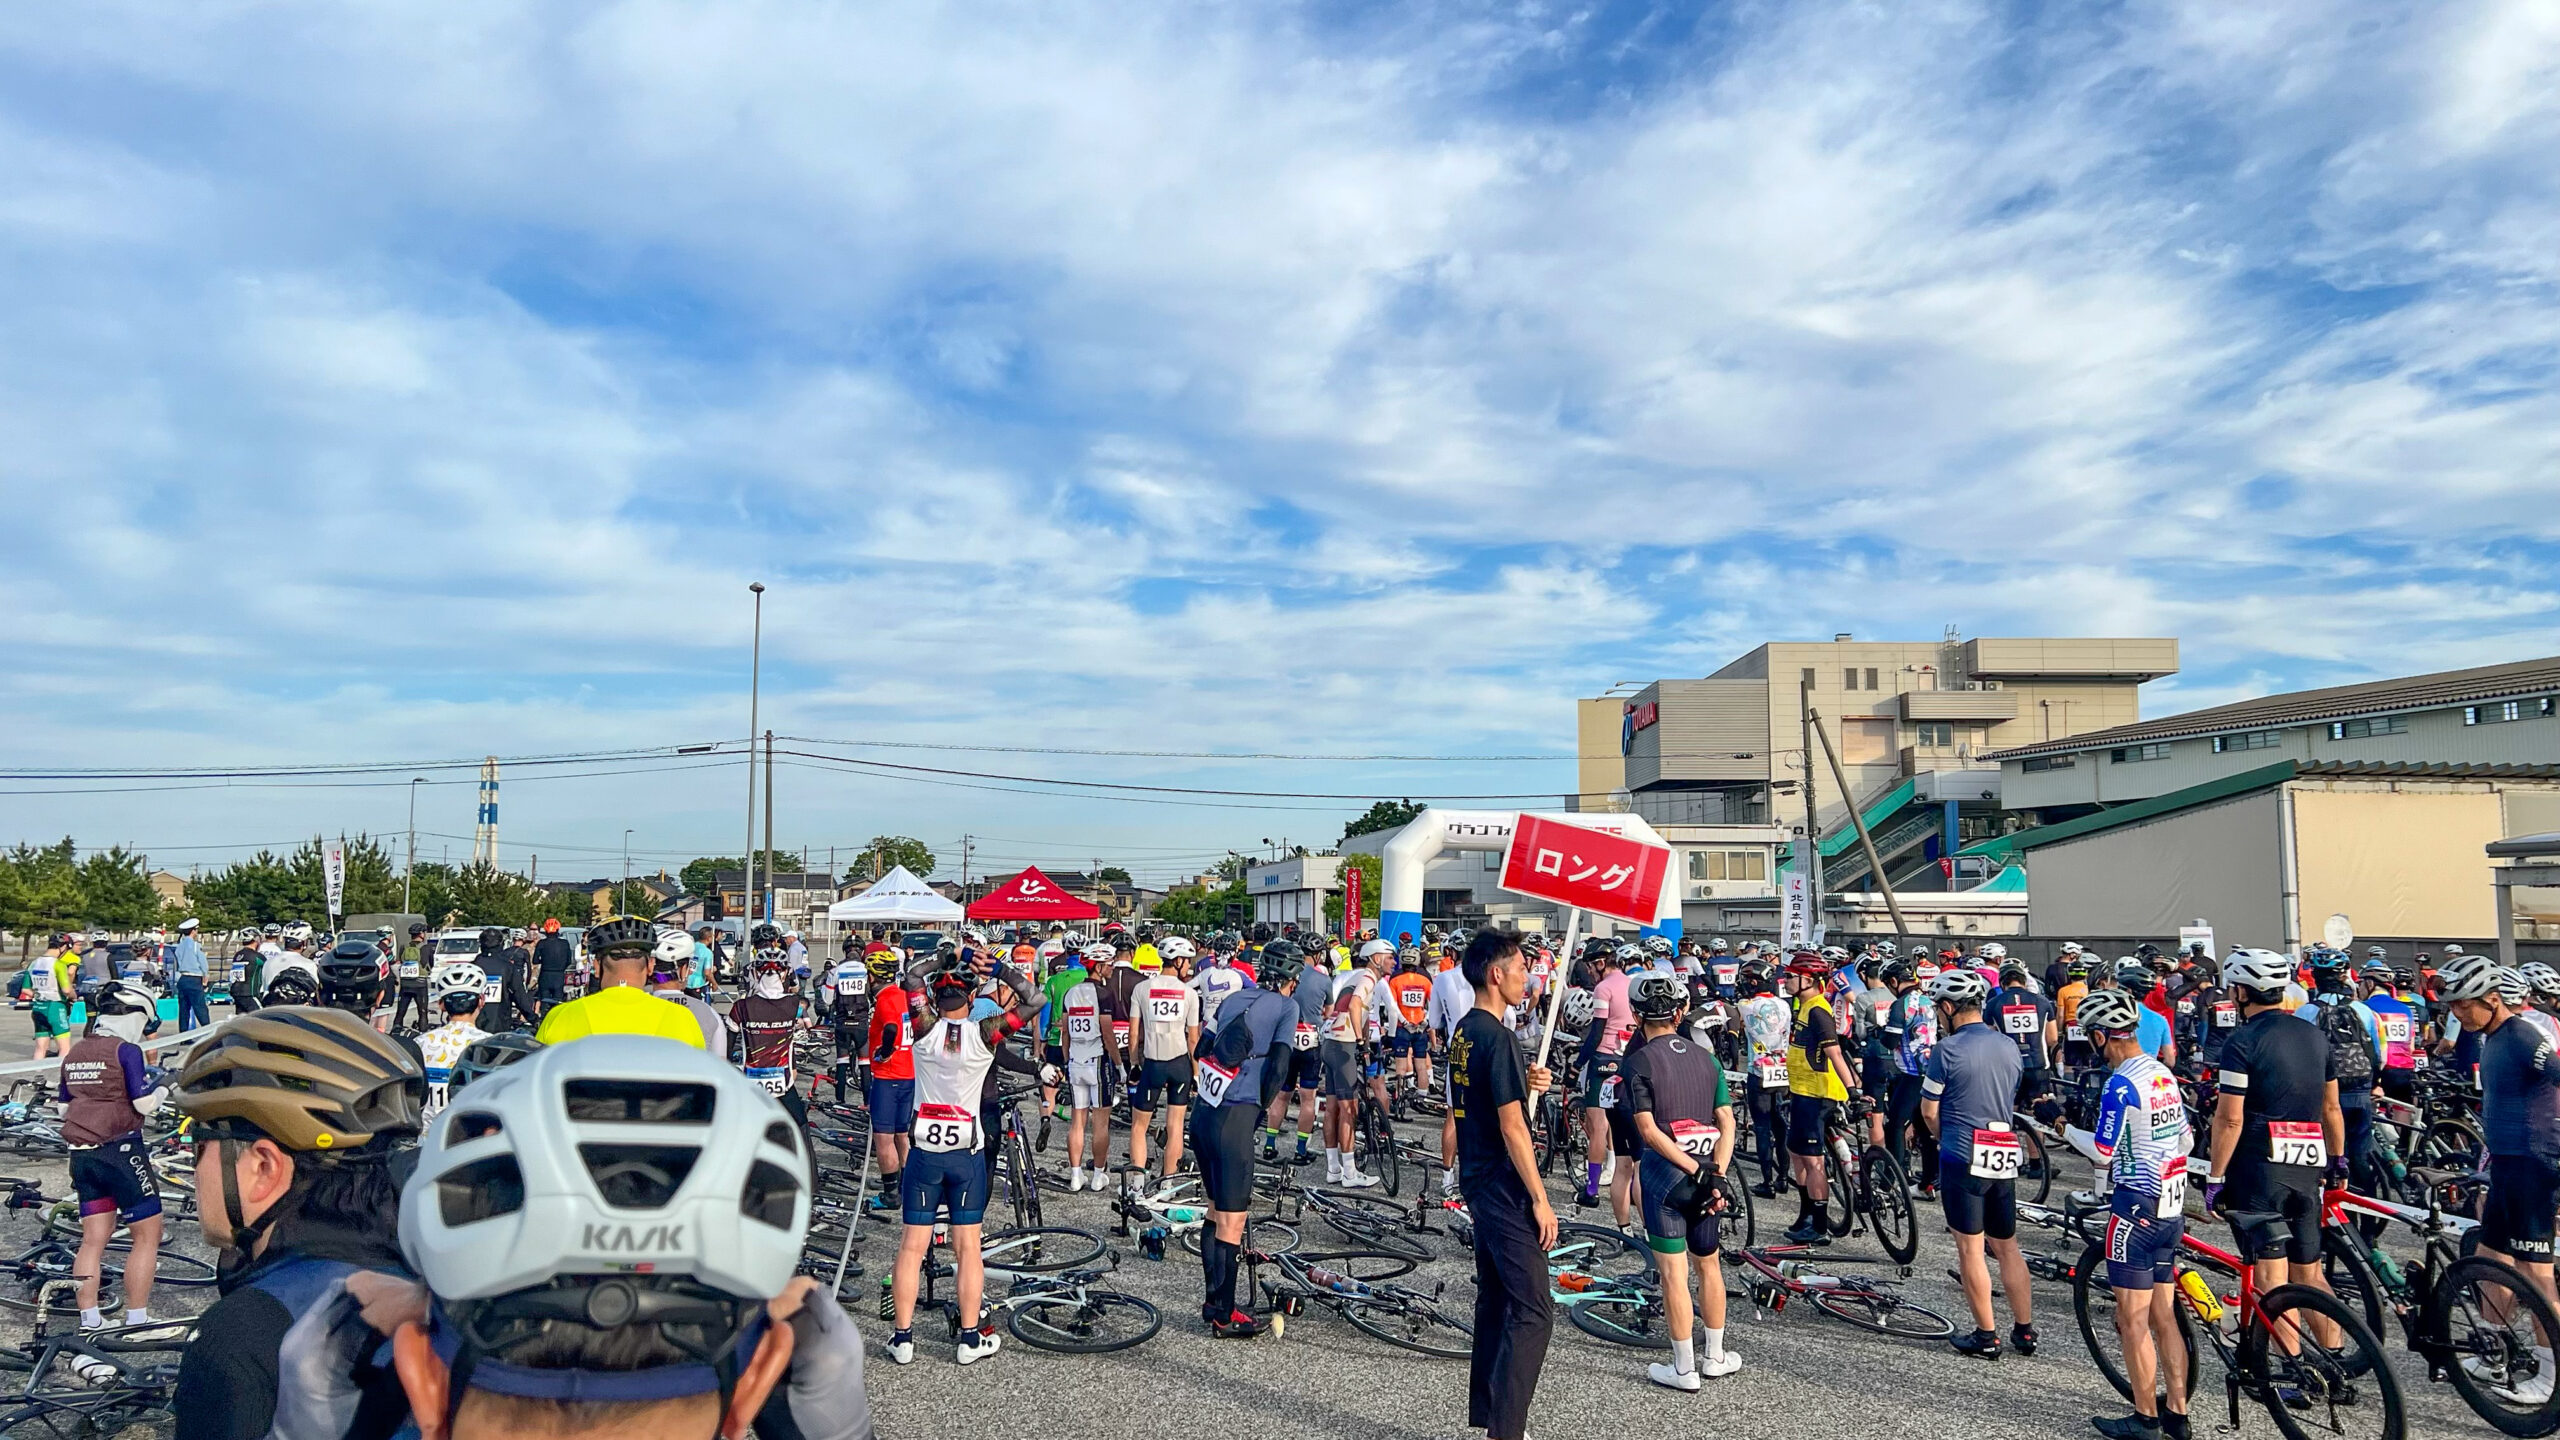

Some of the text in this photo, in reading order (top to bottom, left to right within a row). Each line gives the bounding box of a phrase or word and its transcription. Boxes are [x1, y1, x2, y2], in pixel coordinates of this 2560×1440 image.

[1534, 847, 1635, 891] ロング
[1789, 893, 1804, 941] 北日本新聞
[401, 967, 418, 975] 1049
[1534, 964, 1544, 973] 35
[840, 979, 863, 991] 1148
[1723, 974, 1733, 982] 10
[1404, 993, 1422, 1003] 185
[1152, 1001, 1179, 1016] 134
[1070, 1018, 1091, 1033] 133
[2012, 1015, 2032, 1028] 53
[2384, 1023, 2406, 1037] 168
[76, 1061, 107, 1070] NORMAL
[1201, 1067, 1224, 1097] 140
[1768, 1070, 1789, 1081] 159
[2102, 1110, 2117, 1140] BORA
[2151, 1106, 2182, 1127] BORA
[926, 1123, 960, 1146] 85
[1683, 1137, 1714, 1155] 20
[2280, 1142, 2319, 1166] 179
[1980, 1149, 2017, 1172] 135
[129, 1155, 156, 1197] GARNET
[581, 1223, 685, 1252] KASK
[2113, 1221, 2131, 1262] SOUDAL
[2510, 1238, 2550, 1254] RAPHA
